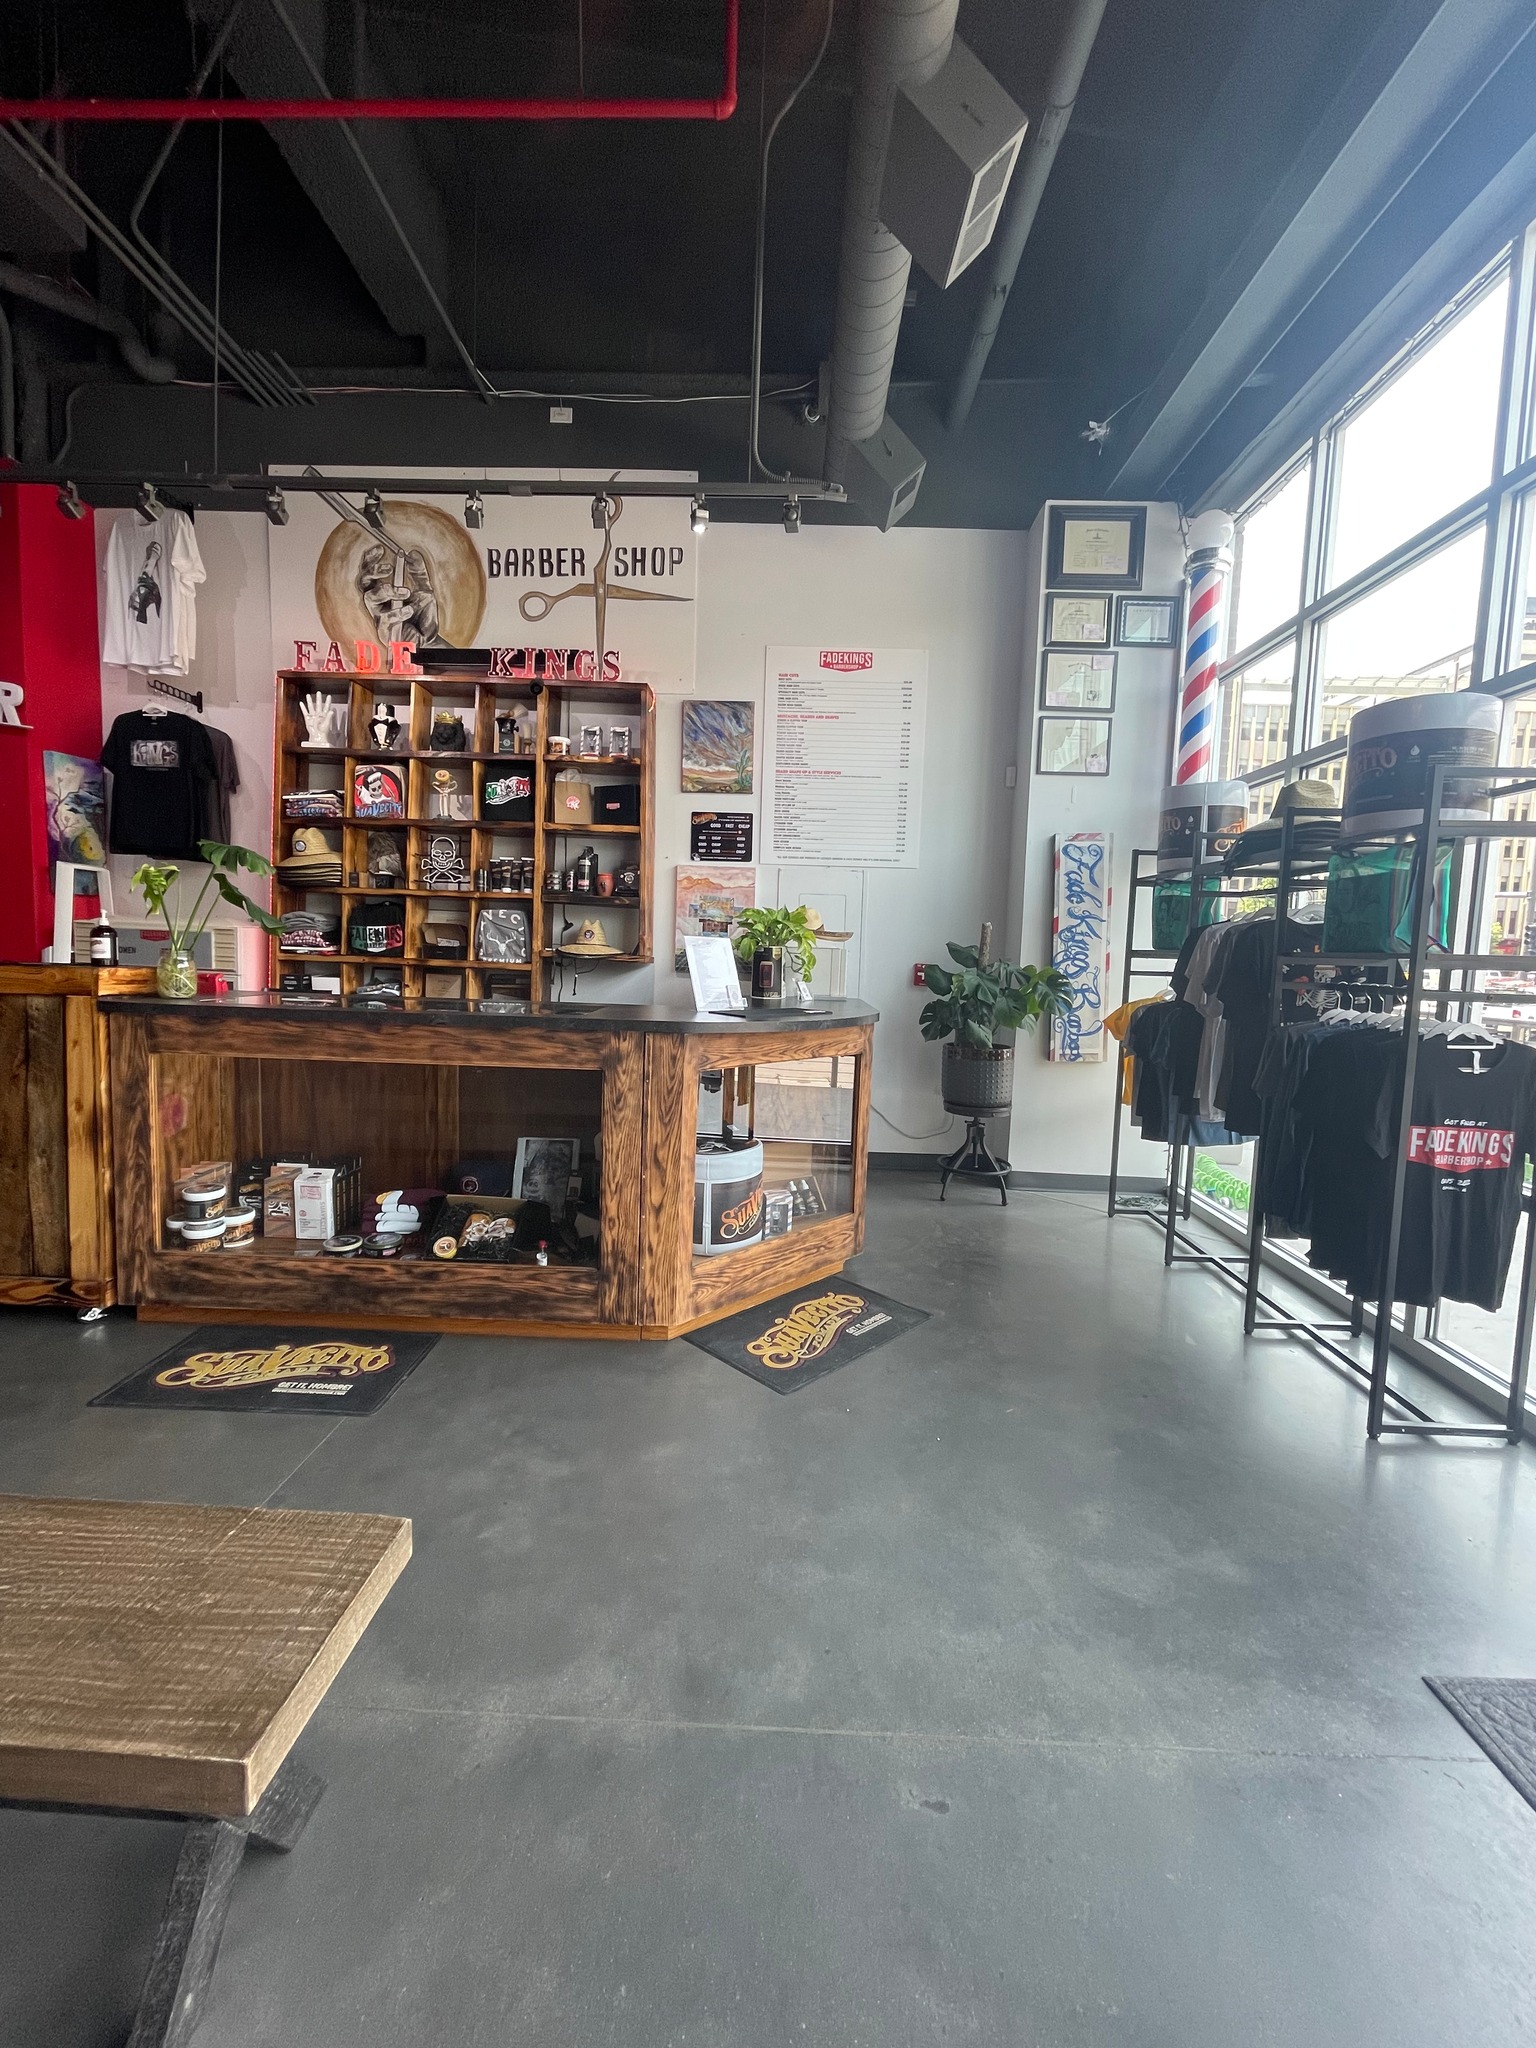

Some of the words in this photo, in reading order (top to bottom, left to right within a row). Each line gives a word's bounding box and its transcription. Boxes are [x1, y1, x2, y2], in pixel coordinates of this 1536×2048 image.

[487, 547, 586, 578] BARBER
[614, 546, 684, 577] SHOP
[293, 640, 418, 675] FADE
[488, 646, 621, 682] KINGS
[820, 652, 872, 667] FADEKINGS
[1061, 843, 1104, 909] Fade
[1053, 906, 1106, 980] Kings
[1409, 1128, 1514, 1163] FADEKINGS
